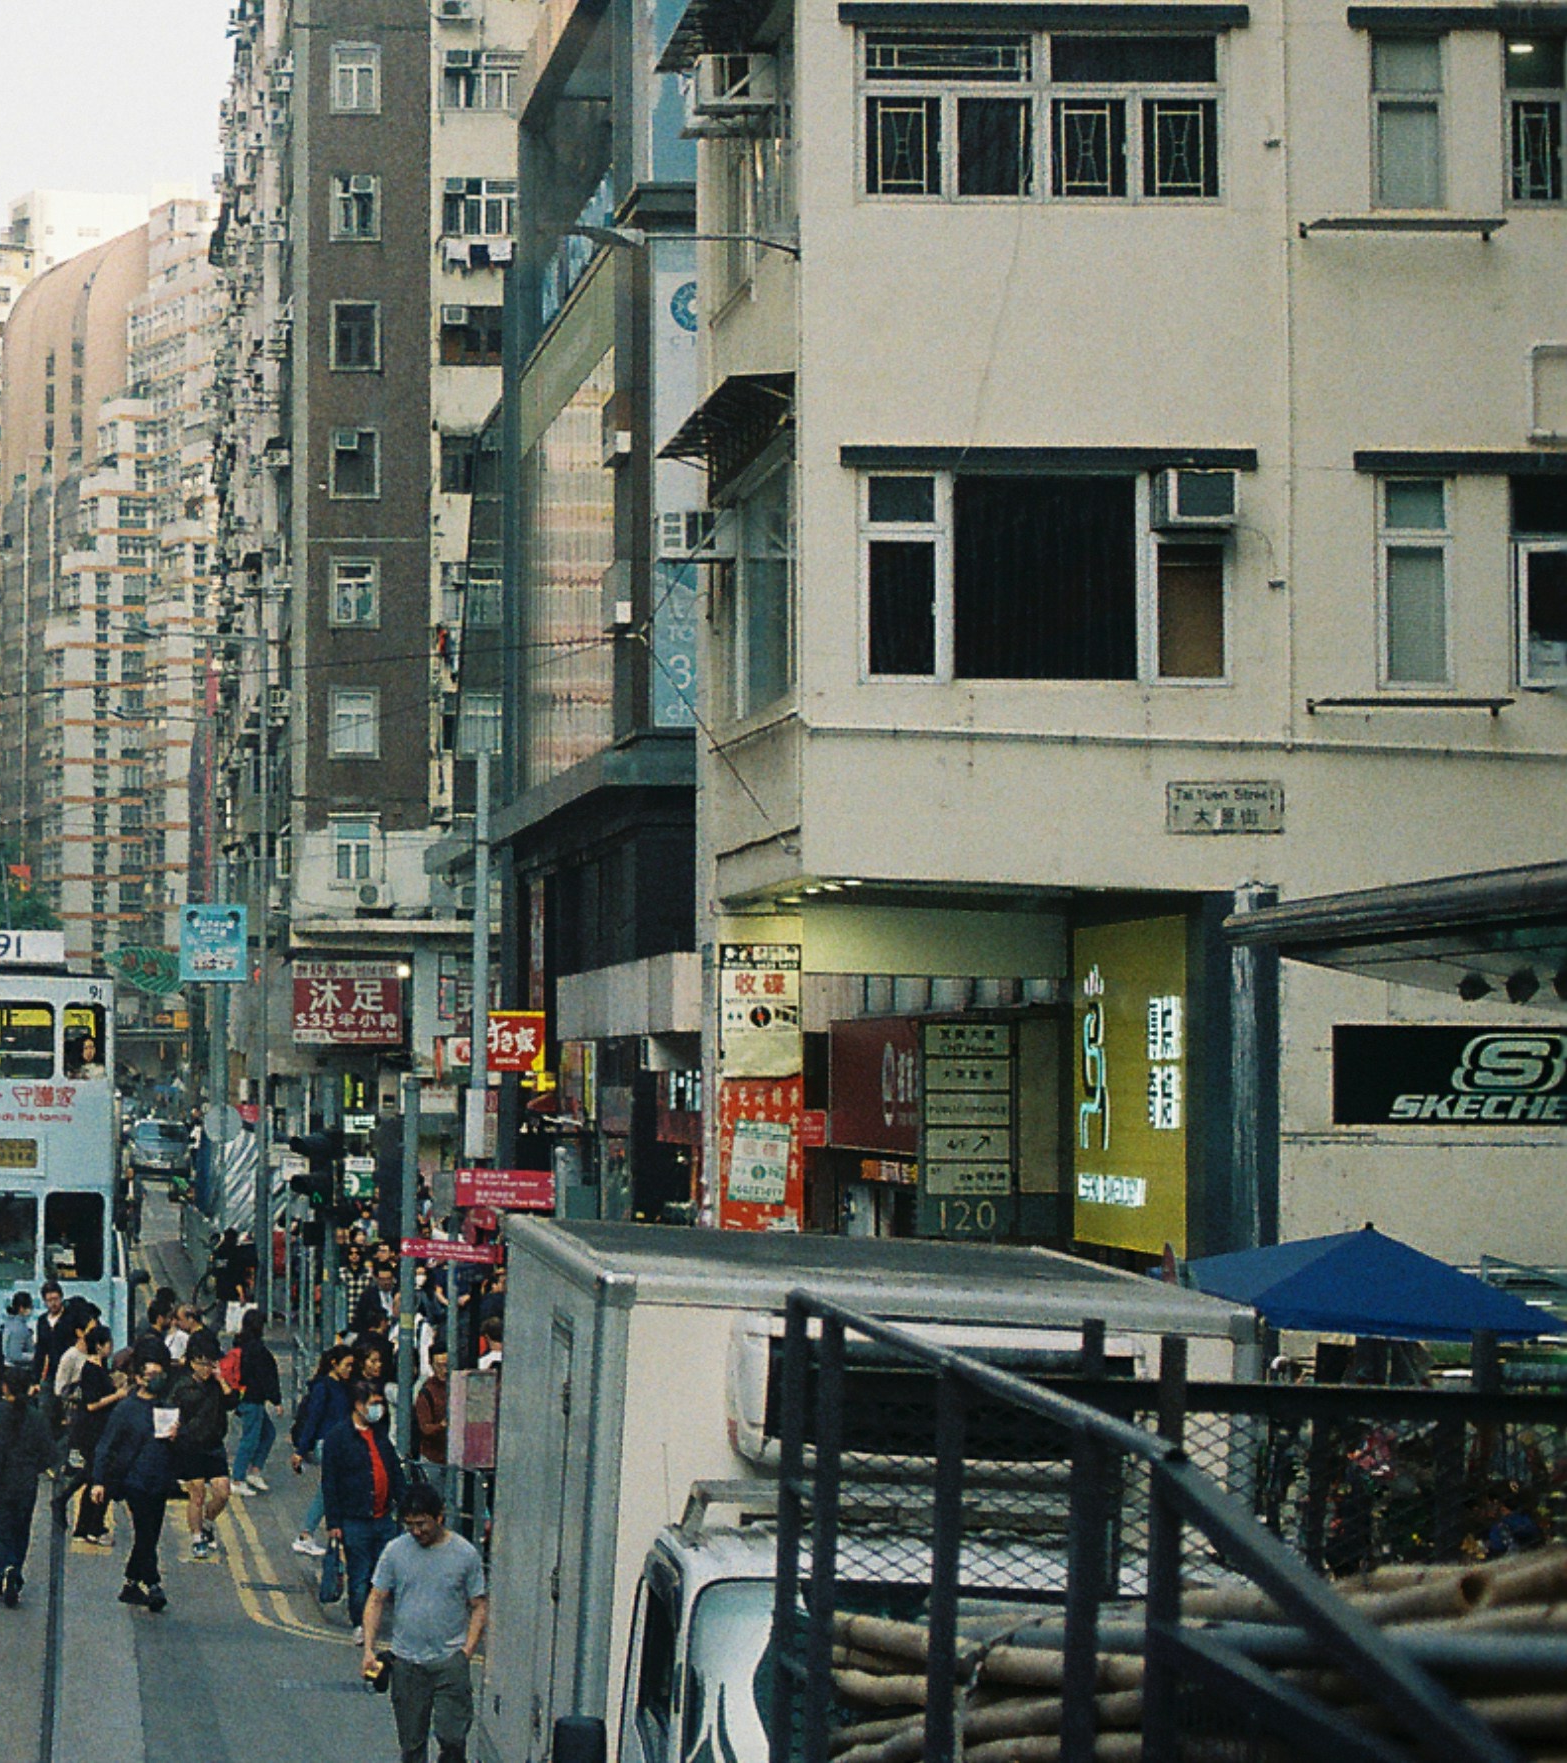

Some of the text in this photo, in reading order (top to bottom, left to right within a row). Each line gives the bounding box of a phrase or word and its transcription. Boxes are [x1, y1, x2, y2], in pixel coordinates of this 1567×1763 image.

[1175, 787, 1194, 801] Tai
[88, 985, 103, 1001] 91
[309, 979, 384, 1013] 沐足
[1389, 1094, 1567, 1120] SKECHE
[940, 1200, 997, 1231] 120
